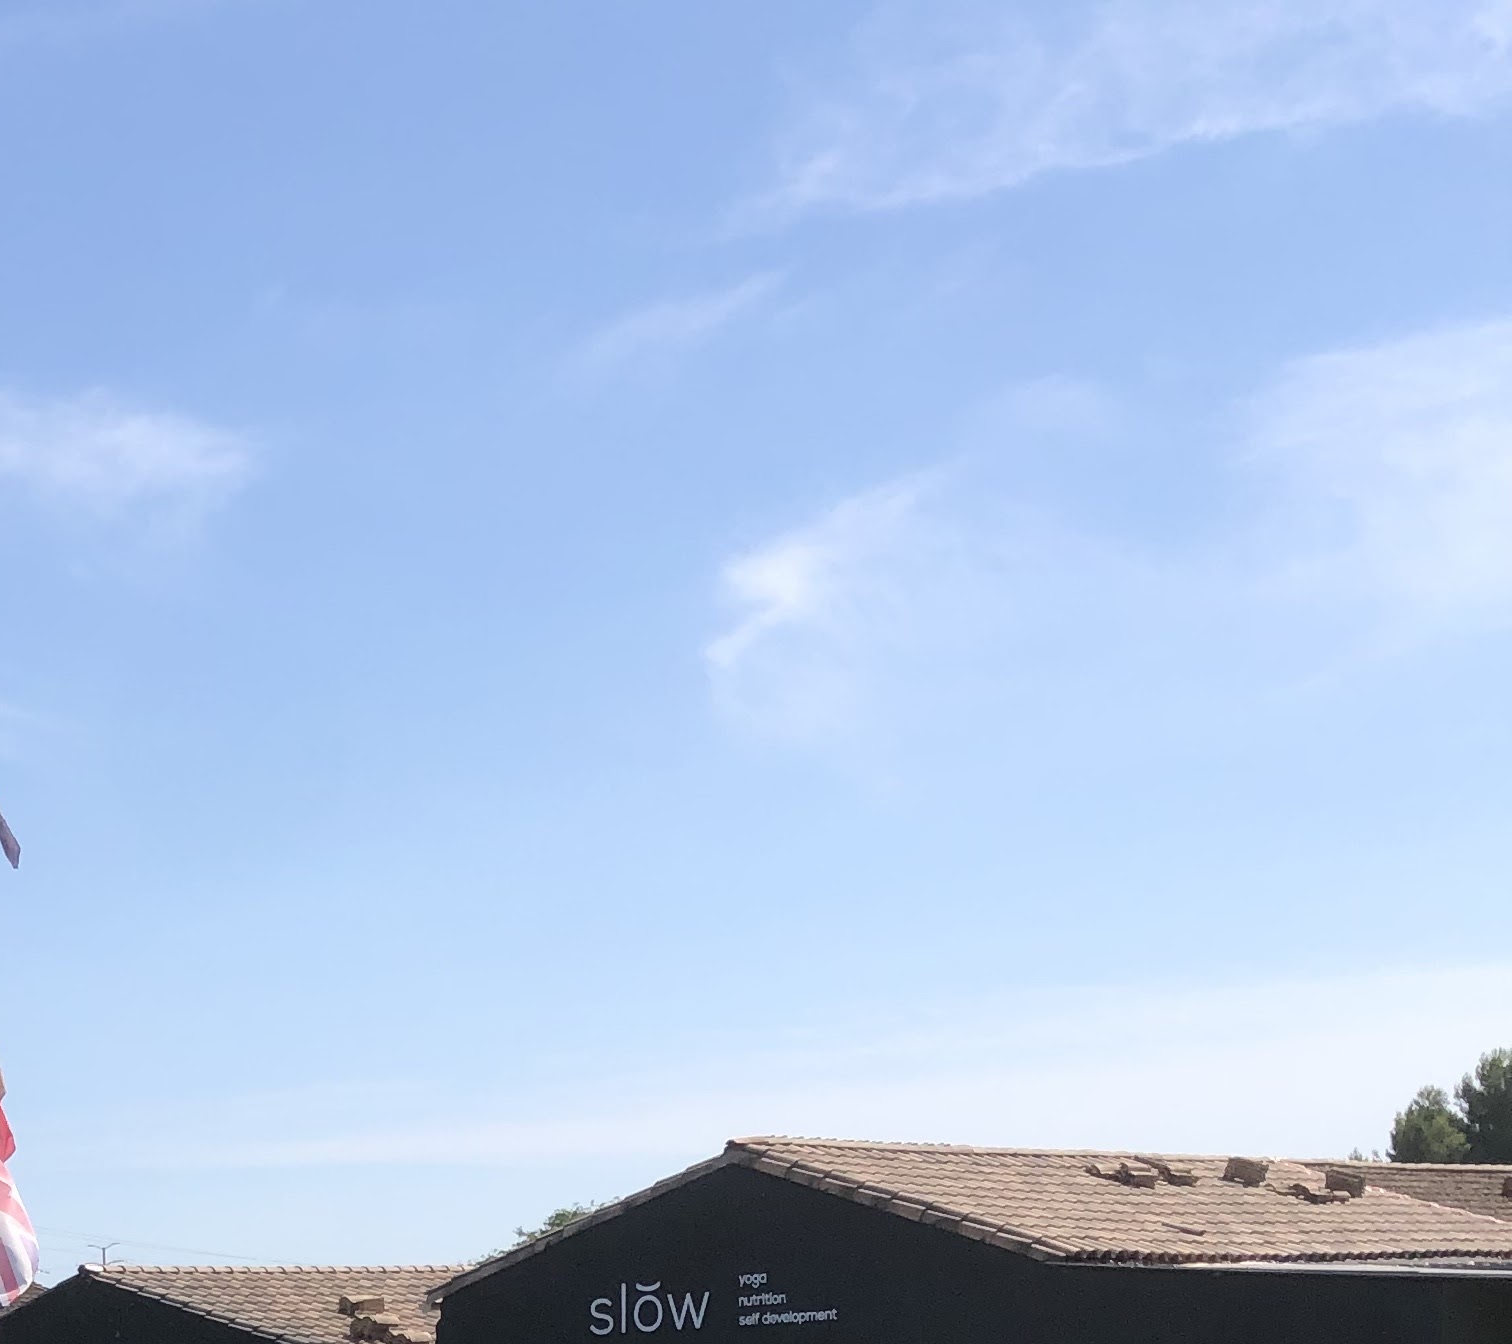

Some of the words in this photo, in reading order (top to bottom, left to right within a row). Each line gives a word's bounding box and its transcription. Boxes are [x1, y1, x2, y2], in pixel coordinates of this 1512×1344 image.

[738, 1271, 767, 1288] yoga
[738, 1292, 787, 1307] nutrition
[738, 1312, 761, 1326] self
[762, 1308, 838, 1325] development
